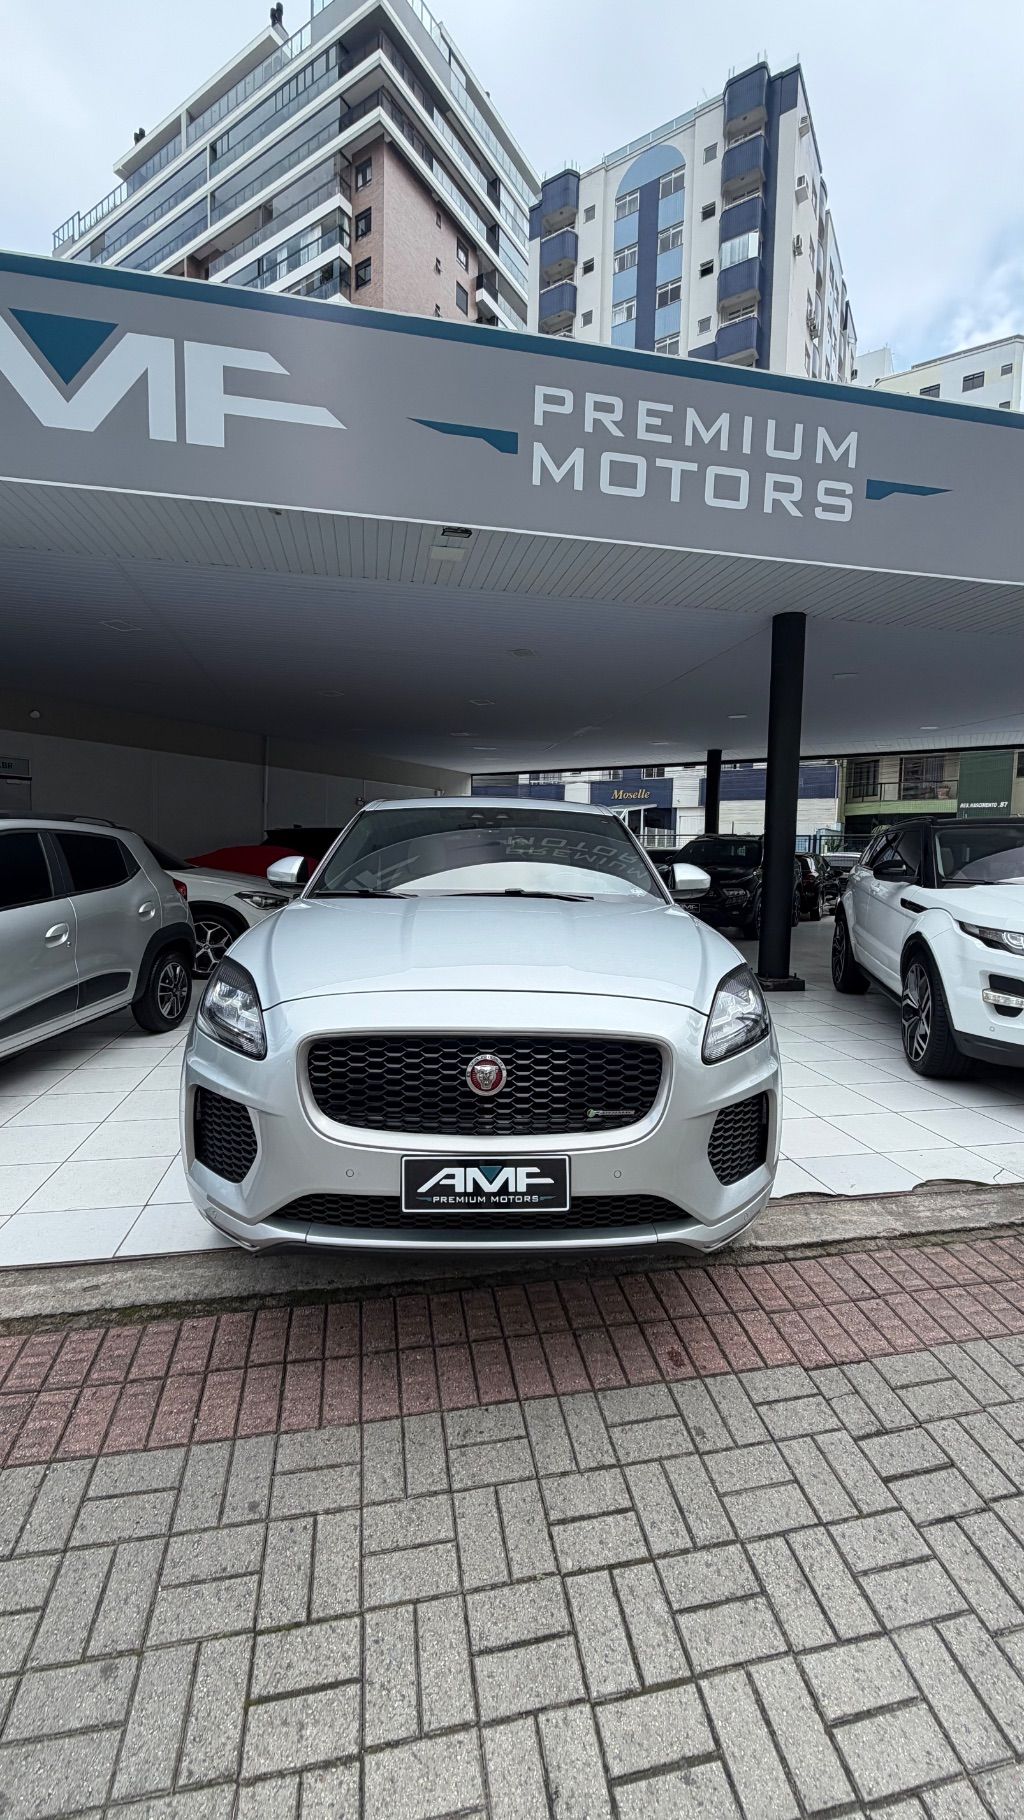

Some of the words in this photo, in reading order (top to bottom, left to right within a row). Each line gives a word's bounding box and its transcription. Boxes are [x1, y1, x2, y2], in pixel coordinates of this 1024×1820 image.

[0, 315, 348, 448] MF
[533, 385, 858, 469] PREMIUM
[532, 442, 854, 522] MOTORS
[611, 789, 651, 800] Moselle
[417, 1167, 555, 1193] AMF
[432, 1196, 486, 1204] PREMIUM
[490, 1195, 539, 1203] MOTORS
